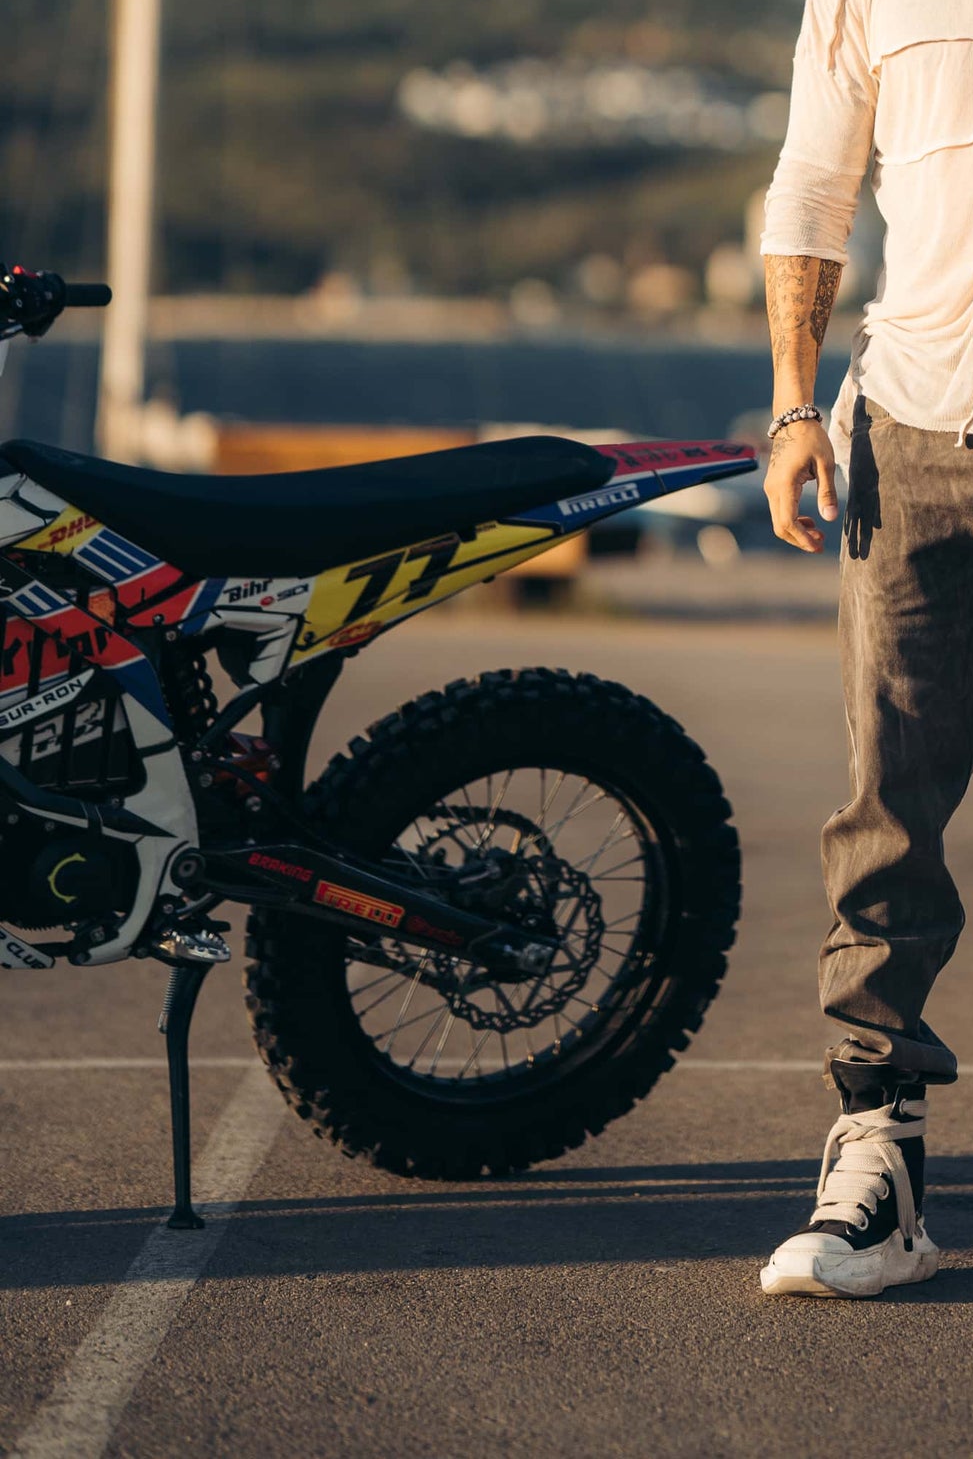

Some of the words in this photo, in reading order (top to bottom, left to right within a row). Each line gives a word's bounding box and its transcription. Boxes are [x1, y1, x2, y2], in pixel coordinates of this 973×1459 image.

[556, 482, 640, 516] PIRELLI
[47, 514, 97, 546] DHL
[223, 579, 273, 603] Bihr
[247, 852, 314, 883] BRAKING
[316, 881, 404, 927] PIRELLI
